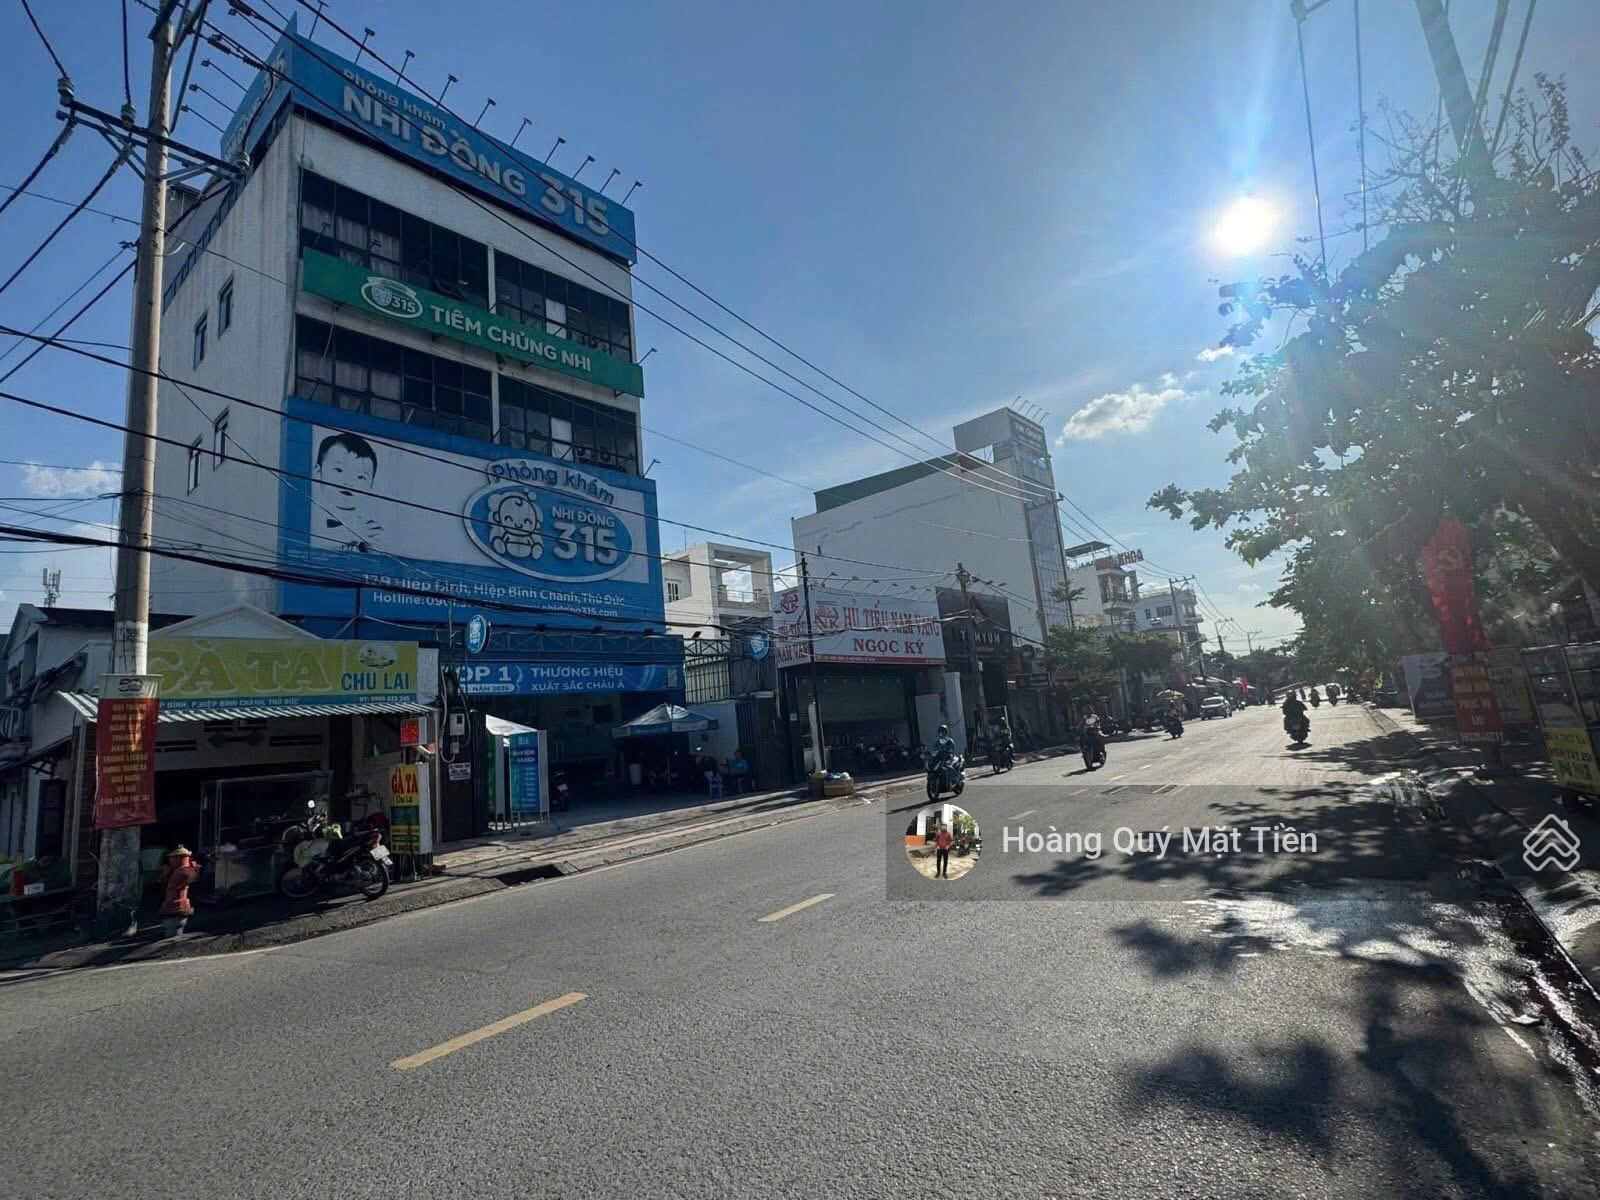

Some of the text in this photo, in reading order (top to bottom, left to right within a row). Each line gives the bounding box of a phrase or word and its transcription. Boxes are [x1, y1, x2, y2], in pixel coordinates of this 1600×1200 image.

[343, 85, 411, 141] NHI
[421, 127, 527, 197] ĐỒNG
[540, 173, 610, 236] 315
[391, 294, 417, 315] 315
[430, 304, 592, 372] TIÊM CHỦNG NHI
[552, 505, 615, 527] NHI ĐỒNG
[552, 521, 618, 565] 315
[854, 639, 924, 656] NGỌC KÝ
[341, 671, 409, 691] CHU LAI
[499, 666, 512, 681] 1
